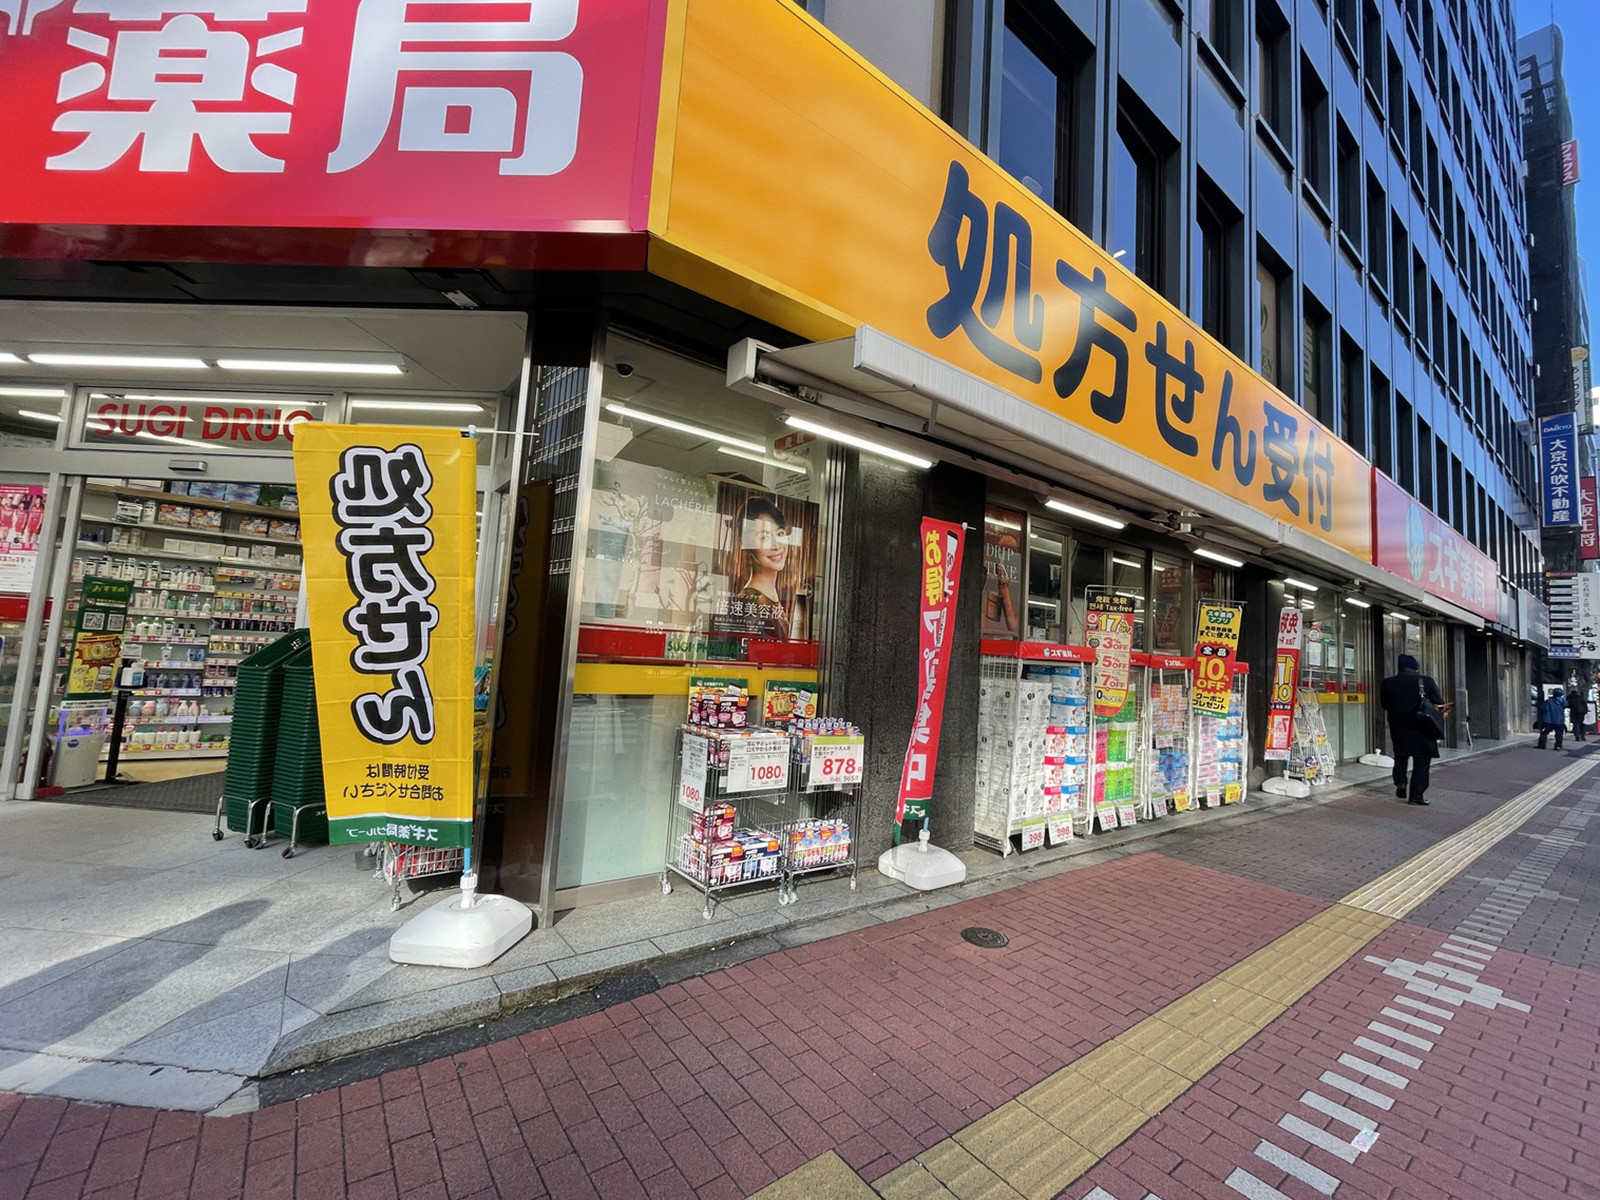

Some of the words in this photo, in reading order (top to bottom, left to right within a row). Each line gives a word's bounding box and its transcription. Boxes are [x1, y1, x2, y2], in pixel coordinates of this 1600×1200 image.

[926, 159, 1335, 533] 処方せん受付
[95, 403, 188, 438] SUGI
[1550, 439, 1570, 523] 大京穴吹不動産
[655, 494, 713, 516] LACHÉRIE
[986, 543, 1014, 561] DRIP
[1429, 531, 1487, 609] スギ薬局
[715, 598, 785, 620] 倍速美容液
[1106, 604, 1133, 612] Tax-free
[1196, 680, 1226, 691] OFF
[1192, 699, 1226, 711] プレゼント
[1196, 692, 1224, 703] クーポン
